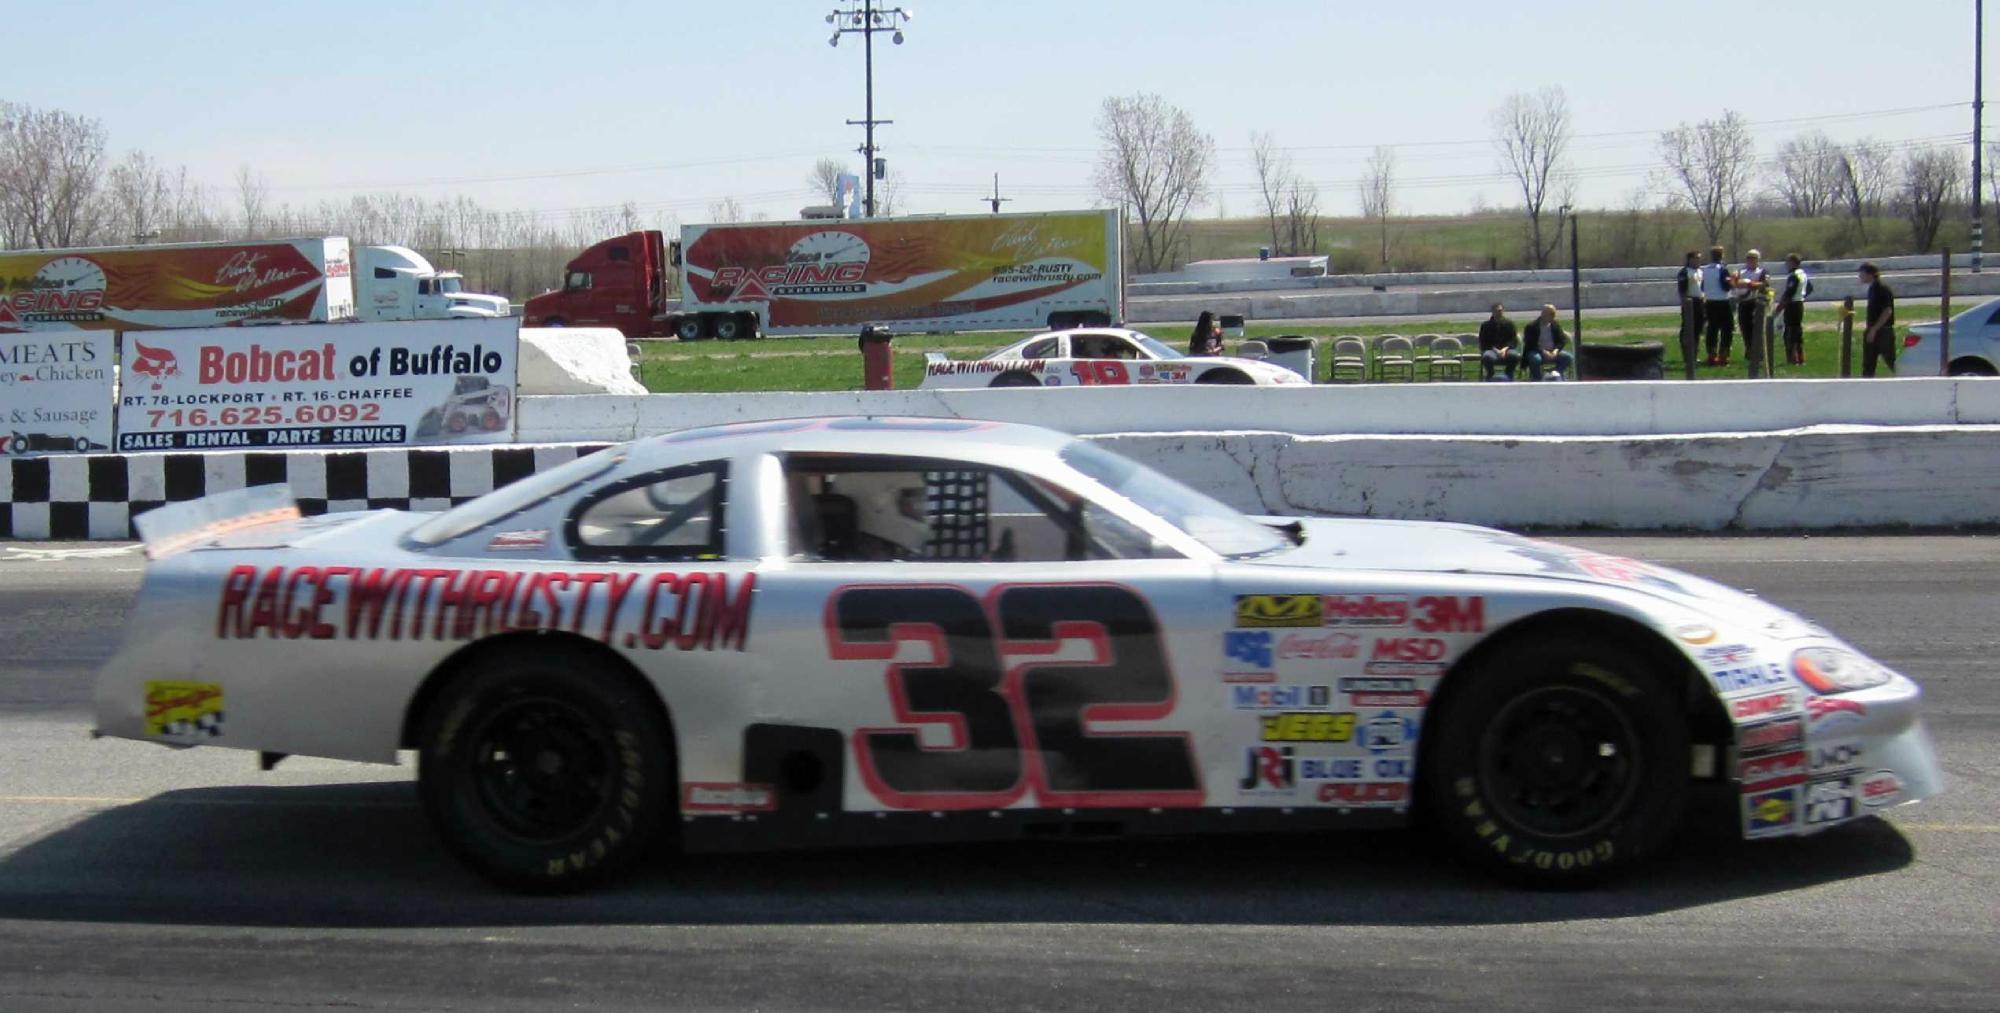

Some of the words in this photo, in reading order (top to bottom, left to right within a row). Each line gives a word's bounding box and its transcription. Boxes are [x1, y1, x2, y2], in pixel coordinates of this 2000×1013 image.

[711, 262, 867, 301] RACING
[778, 285, 863, 294] EXPERIENCE
[36, 365, 104, 381] Chicken
[198, 343, 336, 385] Bobcat
[350, 347, 381, 377] of
[390, 344, 502, 376] Buffalo
[123, 396, 147, 406] RT.
[153, 392, 265, 405] 78-LOCKPORT
[283, 391, 306, 402] RT.
[313, 388, 413, 400] 16-CHAFFEE
[10, 408, 26, 424] &
[33, 407, 98, 425] Sausage
[147, 403, 381, 427] 716.625.6092
[124, 433, 174, 449] SALES
[186, 431, 250, 447] RENTAL
[268, 429, 321, 444] PARTS
[333, 427, 401, 443] SERVICE
[217, 564, 757, 652] RACEWITHRUSTY.COM
[1414, 596, 1485, 633] 3M
[1372, 638, 1448, 661] MSD
[822, 581, 1206, 811] 32
[1233, 686, 1301, 706] Mobil
[1301, 759, 1362, 779] BLUE
